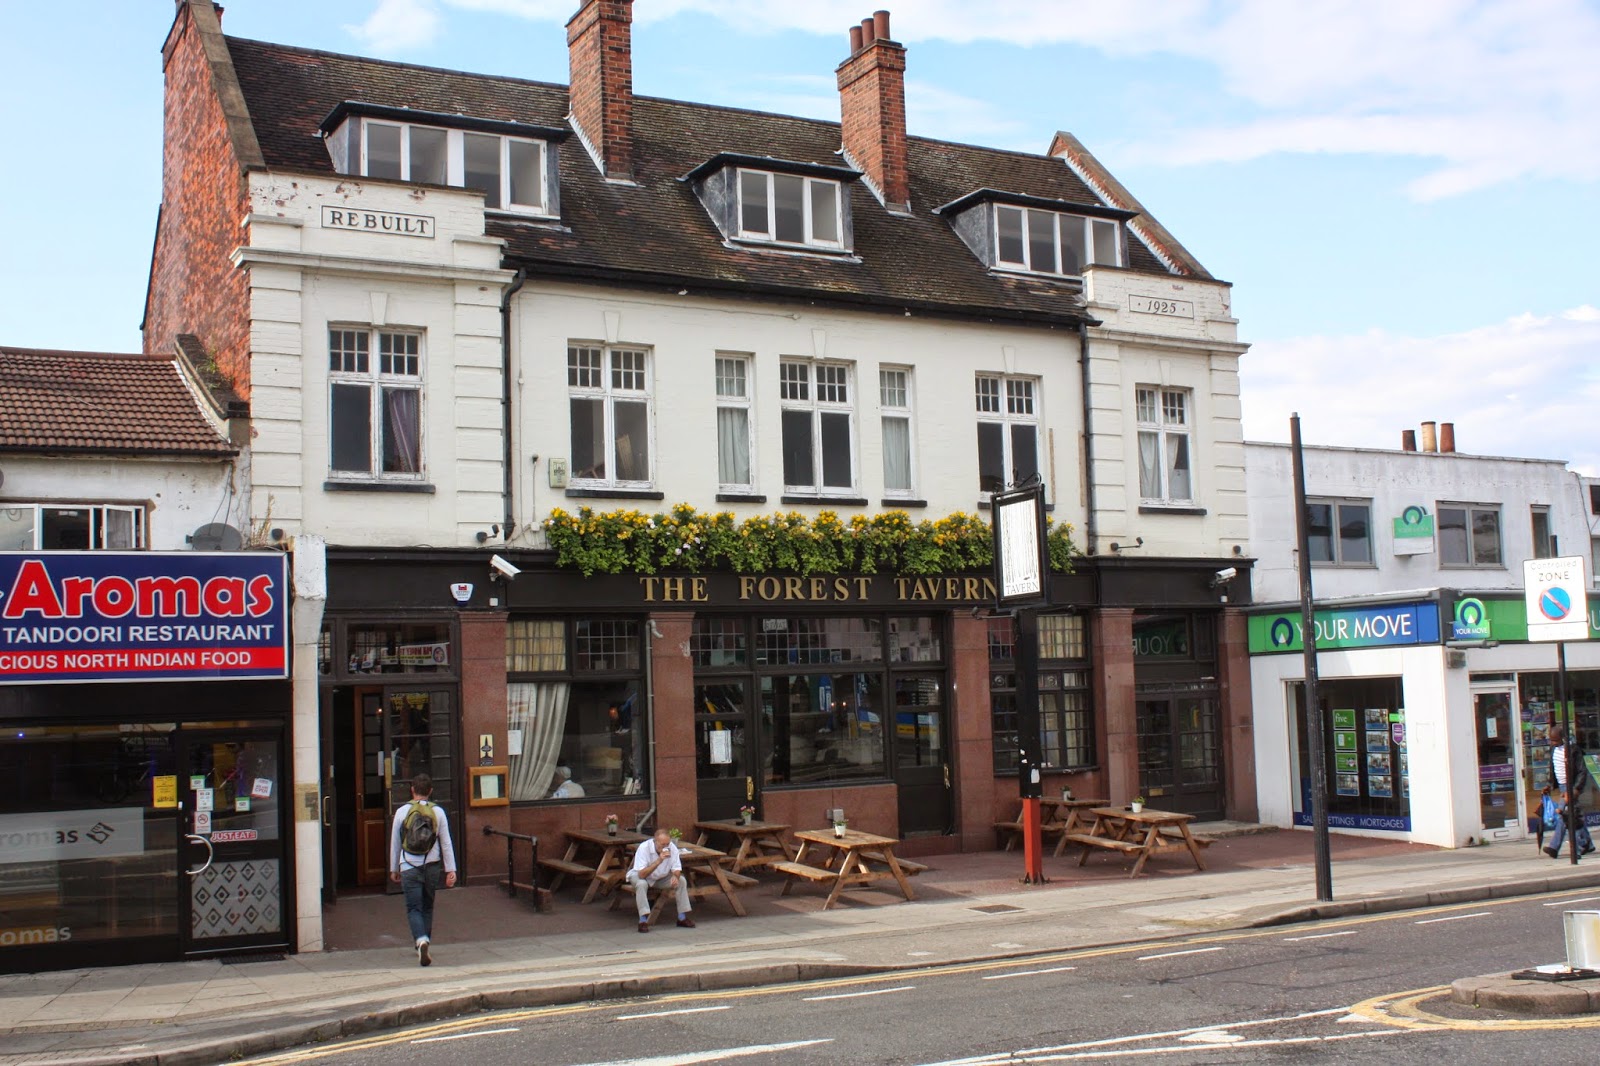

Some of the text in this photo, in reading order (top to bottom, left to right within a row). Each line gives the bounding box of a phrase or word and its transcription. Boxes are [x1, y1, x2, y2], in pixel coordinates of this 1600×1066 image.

[330, 210, 429, 235] REBUILT
[1147, 300, 1177, 314] 1925
[1538, 571, 1570, 582] ZONE
[2, 560, 274, 619] Aromas
[639, 576, 709, 602] THE
[738, 576, 872, 601] FOREST
[1005, 581, 1039, 595] TAVERN
[2, 624, 275, 643] TANDOORI RESTAURANT
[1354, 613, 1412, 639] MOVE
[64, 653, 128, 669] NORTH
[134, 651, 196, 667] INDIAN
[201, 651, 251, 666] FOOD
[1327, 815, 1355, 826] ETTINGS
[1360, 817, 1405, 829] MORTGAGES
[212, 831, 233, 841] JUST
[234, 831, 251, 841] EAT
